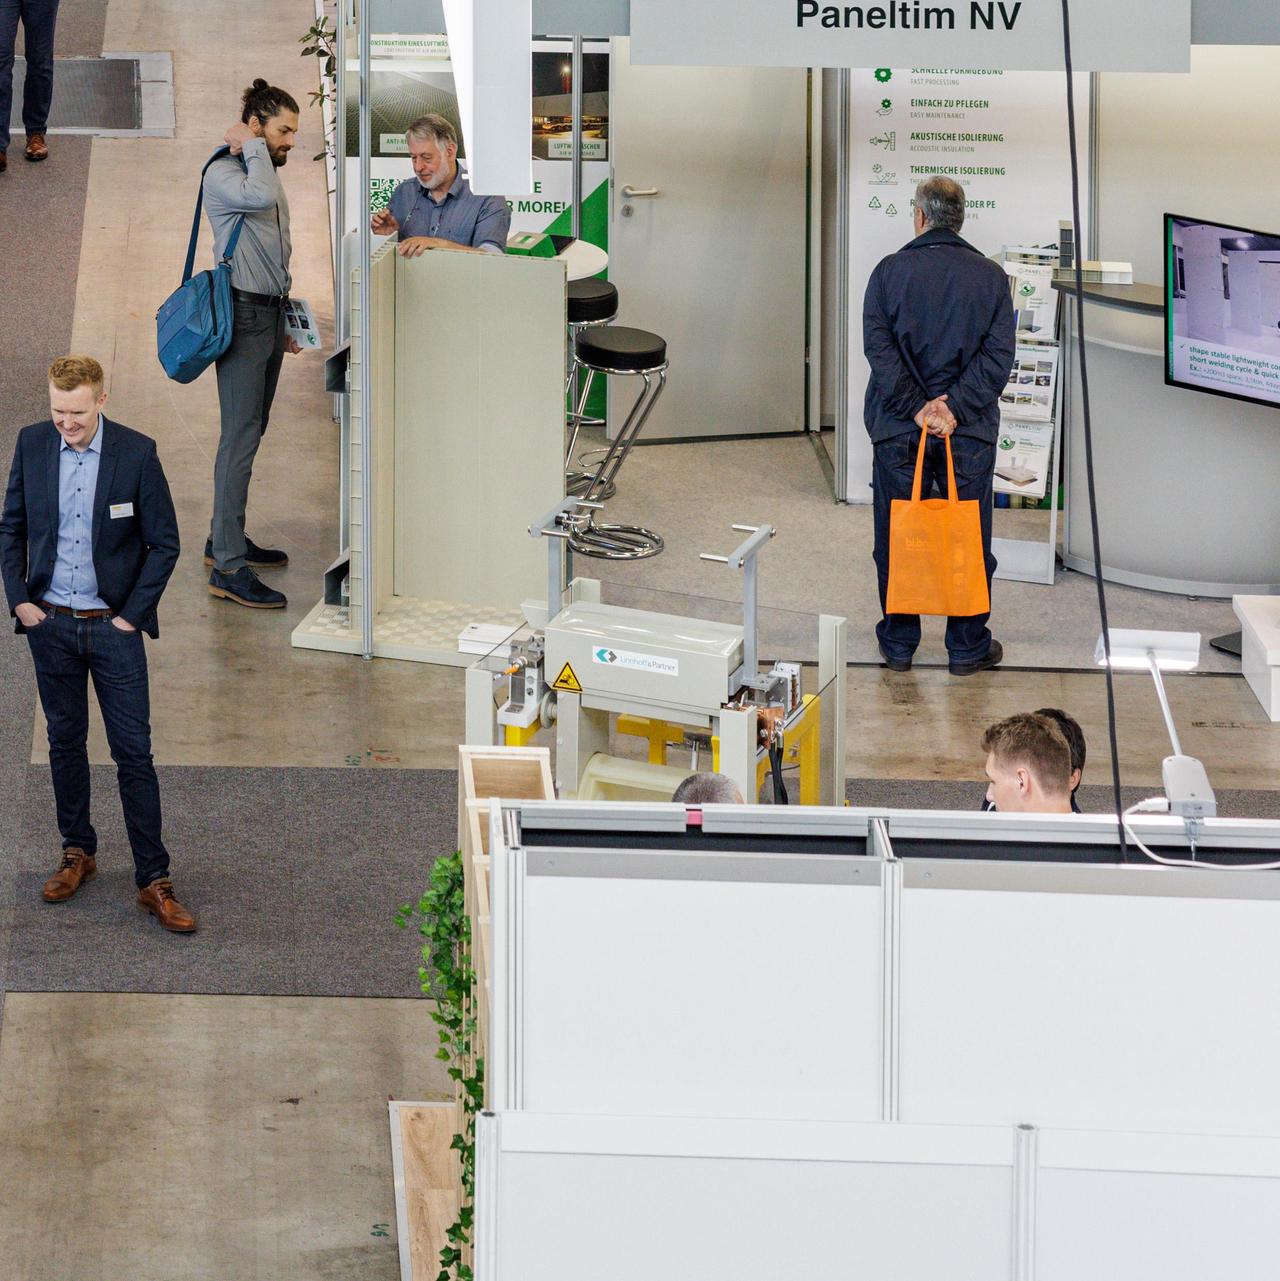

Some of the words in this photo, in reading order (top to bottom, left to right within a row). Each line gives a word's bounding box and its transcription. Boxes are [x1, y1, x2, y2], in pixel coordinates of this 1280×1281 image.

[968, 1, 1022, 32] NV
[911, 98, 942, 108] EINFACH
[944, 99, 954, 108] ZU
[956, 99, 989, 109] PFLEGEN
[926, 112, 965, 120] MAINTENANCE
[910, 132, 956, 142] AKUSTISCHE
[958, 133, 1004, 143] ISOLIERUNG
[910, 165, 958, 175] THERMISCHE
[960, 166, 1006, 176] ISOLIERUNG
[518, 201, 566, 213] MORE!
[1189, 346, 1209, 355] shape
[1210, 351, 1231, 360] stable
[1232, 355, 1269, 368] lightweight
[1189, 355, 1207, 364] short
[1208, 359, 1235, 371] welding
[1235, 365, 1252, 374] cycle
